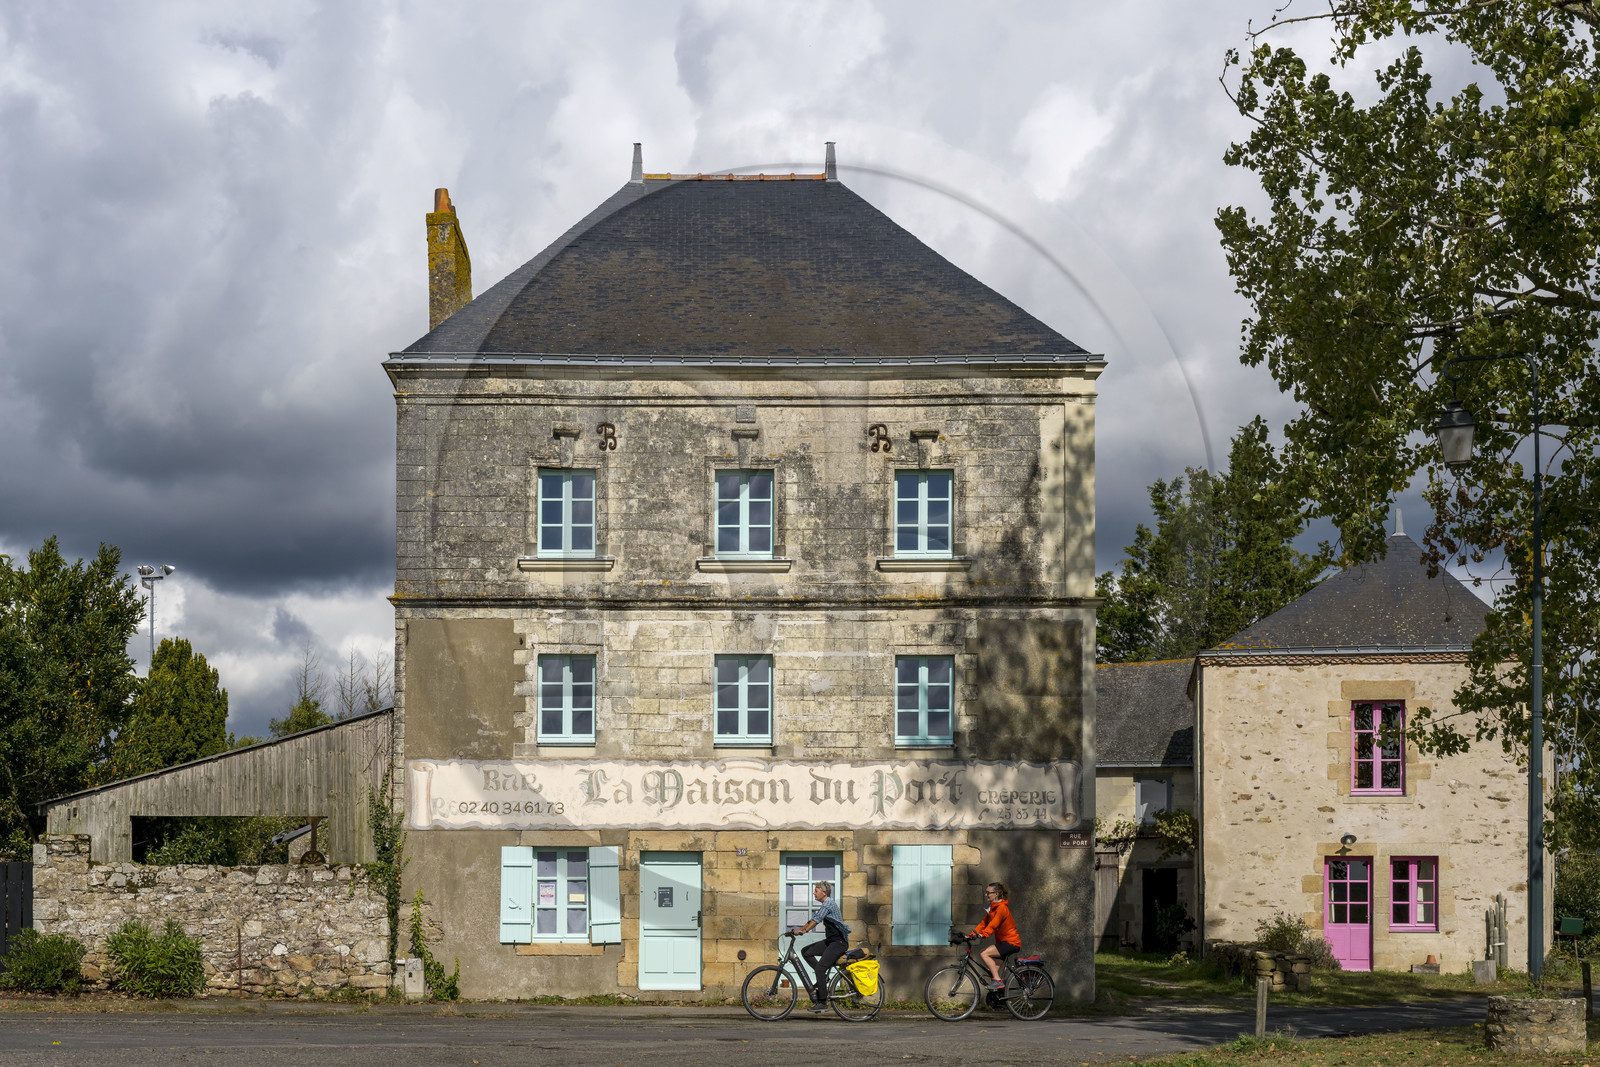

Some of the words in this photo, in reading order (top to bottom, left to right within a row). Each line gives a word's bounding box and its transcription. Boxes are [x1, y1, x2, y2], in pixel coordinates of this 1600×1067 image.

[575, 768, 634, 807] La
[641, 768, 794, 815] Maison
[808, 767, 860, 806] du
[869, 768, 967, 819] Port
[458, 801, 478, 814] 02
[480, 801, 499, 814] 40
[502, 801, 521, 815] 34
[524, 801, 542, 814] 61
[546, 801, 565, 815] 73
[996, 806, 1012, 820] 25
[1032, 807, 1047, 820] 44
